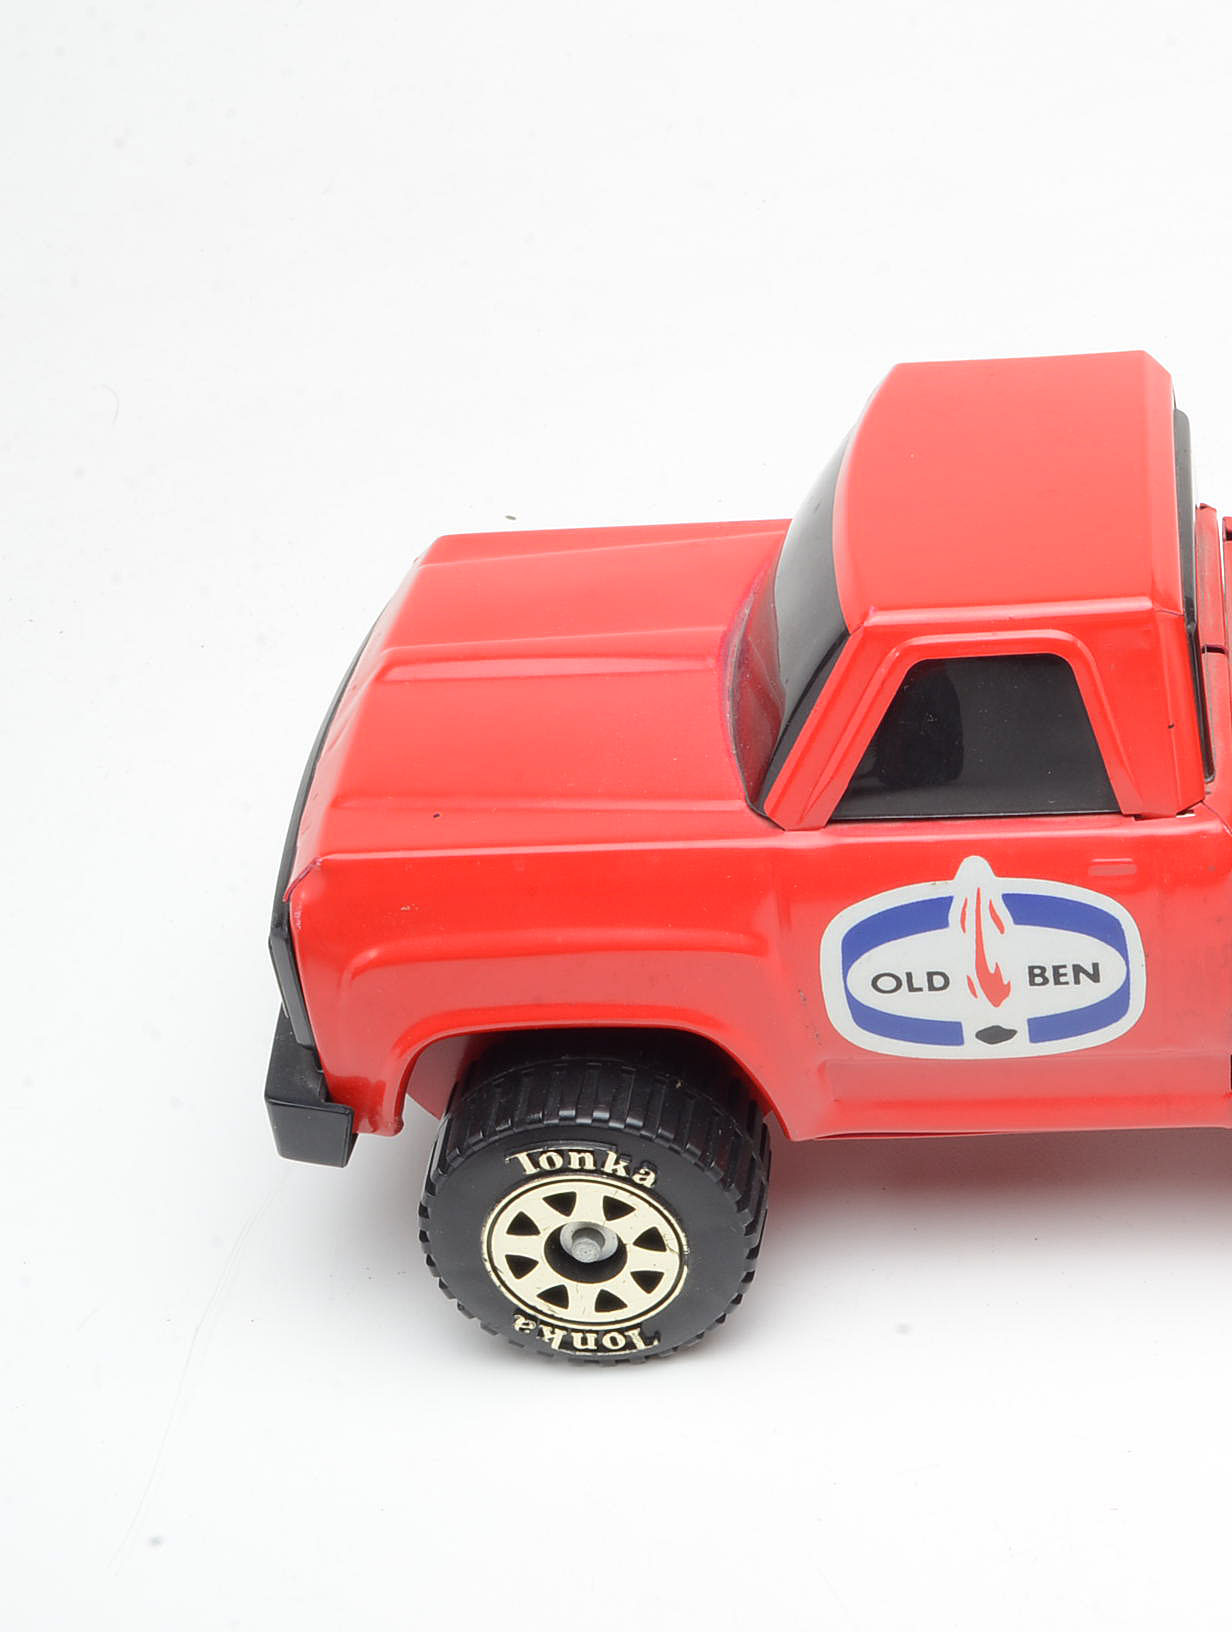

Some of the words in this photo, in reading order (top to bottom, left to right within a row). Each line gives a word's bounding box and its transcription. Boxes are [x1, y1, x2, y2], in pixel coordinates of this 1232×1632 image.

[871, 970, 950, 993] OLD
[1027, 961, 1101, 987] BEN
[505, 1147, 658, 1189] Tonka
[512, 1312, 661, 1351] Tonka
